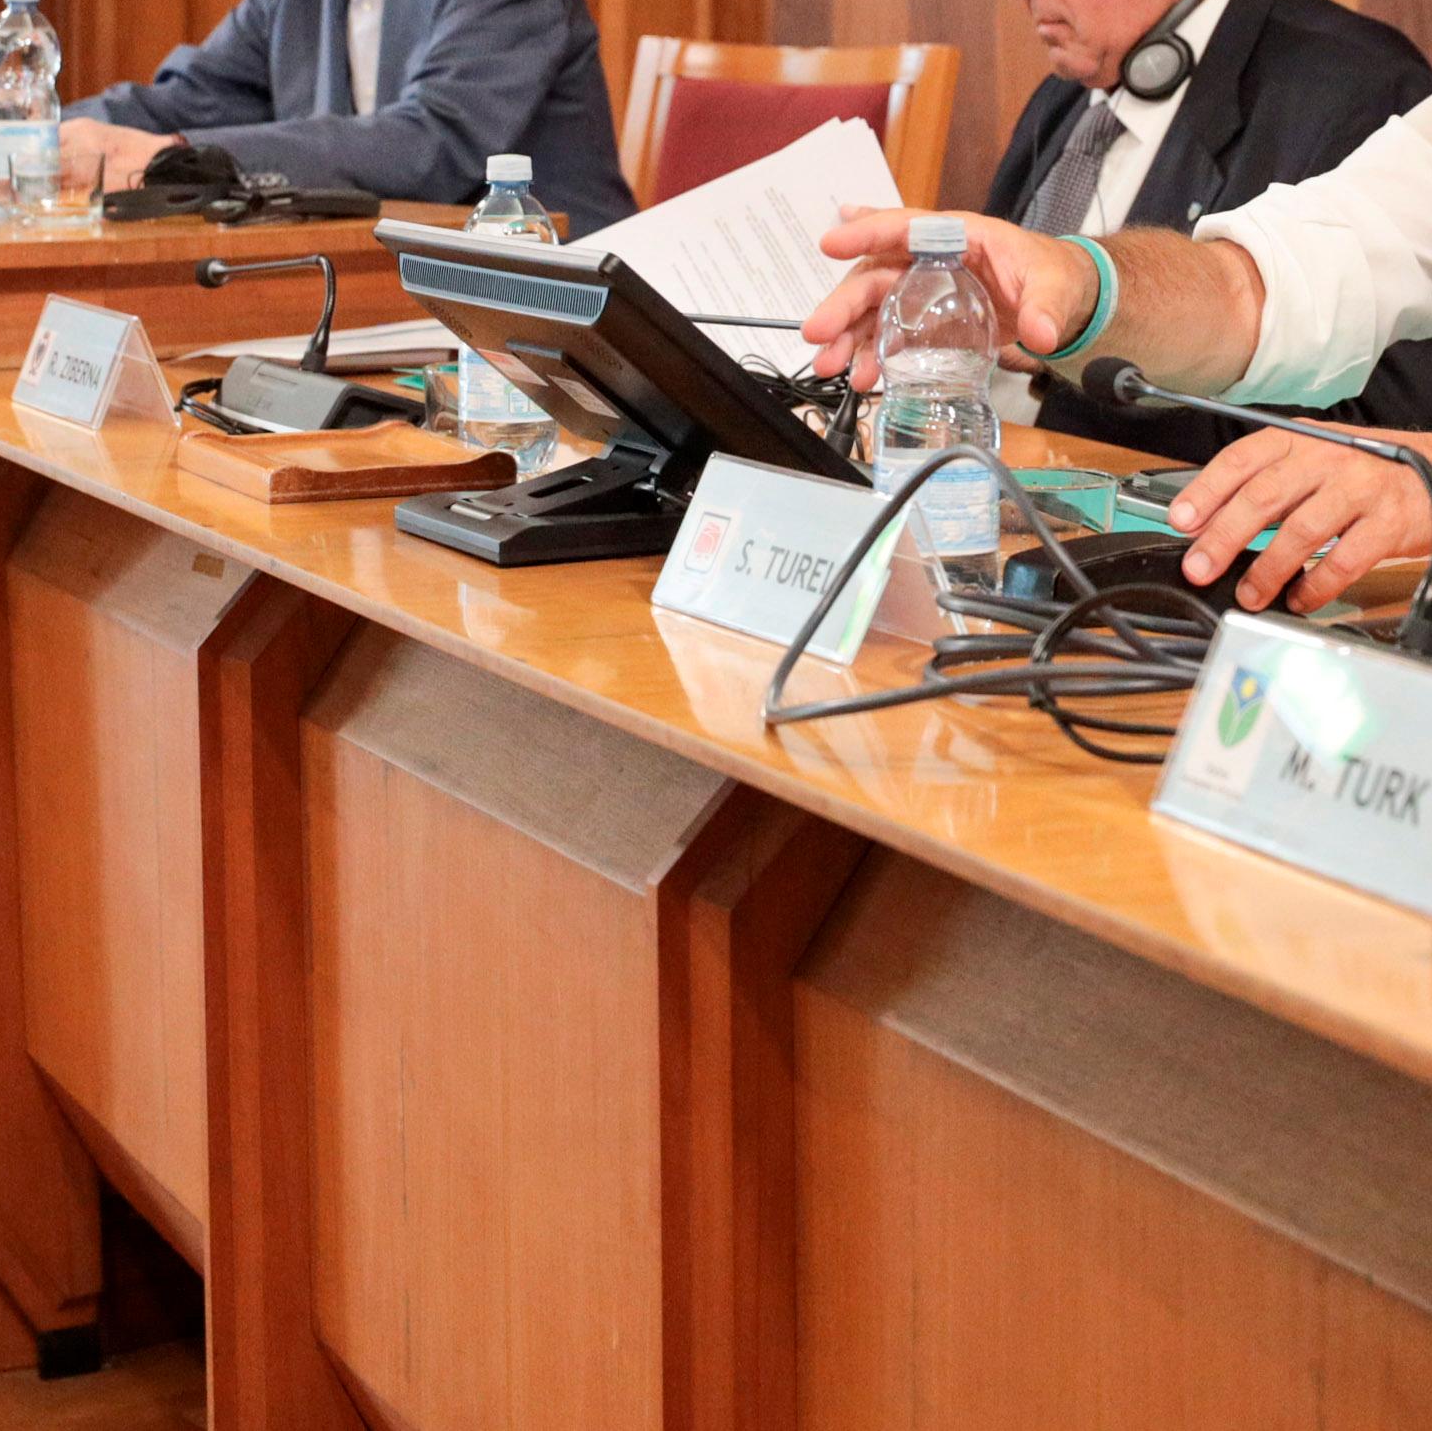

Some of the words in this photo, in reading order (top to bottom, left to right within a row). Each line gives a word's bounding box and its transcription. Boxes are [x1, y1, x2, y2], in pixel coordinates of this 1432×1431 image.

[734, 539, 754, 576] S.
[1279, 743, 1316, 793] M.
[1333, 754, 1432, 829] TURK
